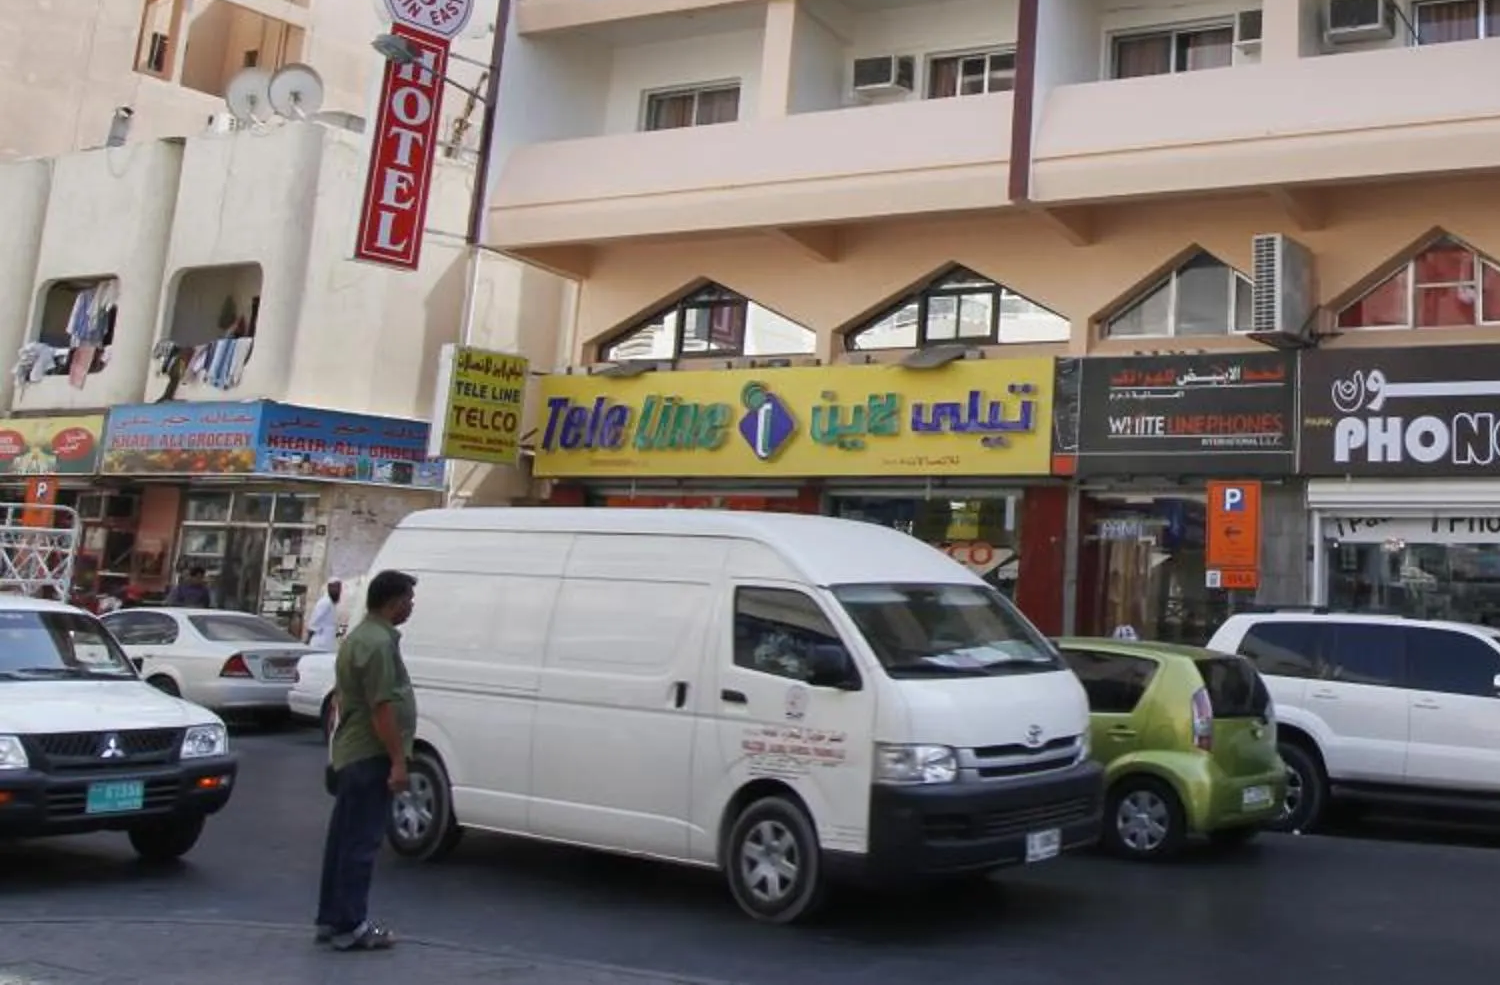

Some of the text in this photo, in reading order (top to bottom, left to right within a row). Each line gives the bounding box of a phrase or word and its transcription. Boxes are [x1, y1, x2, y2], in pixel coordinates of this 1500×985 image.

[374, 48, 437, 252] HOTEL
[455, 380, 521, 403] TELE LINE
[453, 405, 517, 433] TELCO
[541, 394, 733, 451] Tele Line
[1109, 416, 1165, 435] WHITE
[1224, 488, 1241, 511] P
